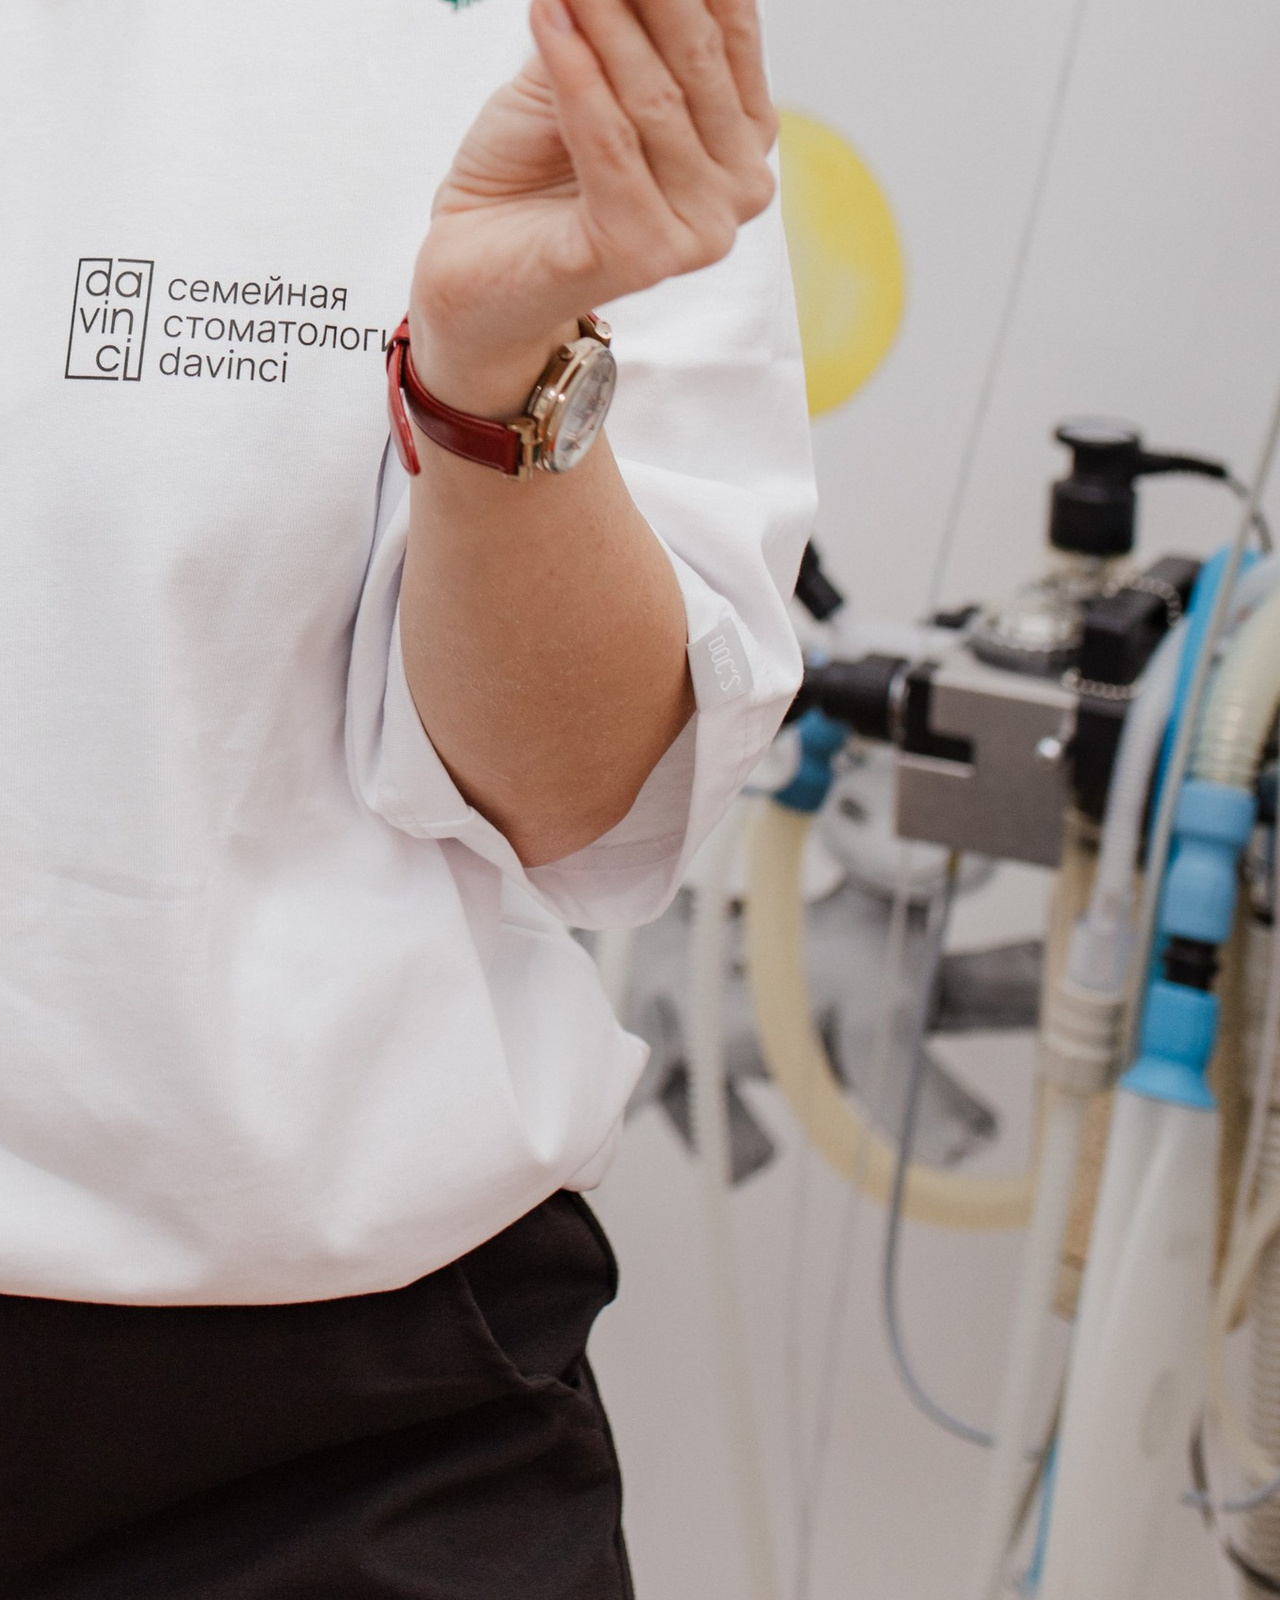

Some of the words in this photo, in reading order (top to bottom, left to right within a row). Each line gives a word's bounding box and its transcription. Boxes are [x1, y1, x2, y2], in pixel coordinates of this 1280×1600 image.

[85, 268, 144, 299] da
[167, 275, 349, 311] семейная
[79, 300, 134, 335] vin
[95, 337, 132, 376] ci
[158, 346, 289, 384] davinci
[707, 634, 741, 692] DOC'S
